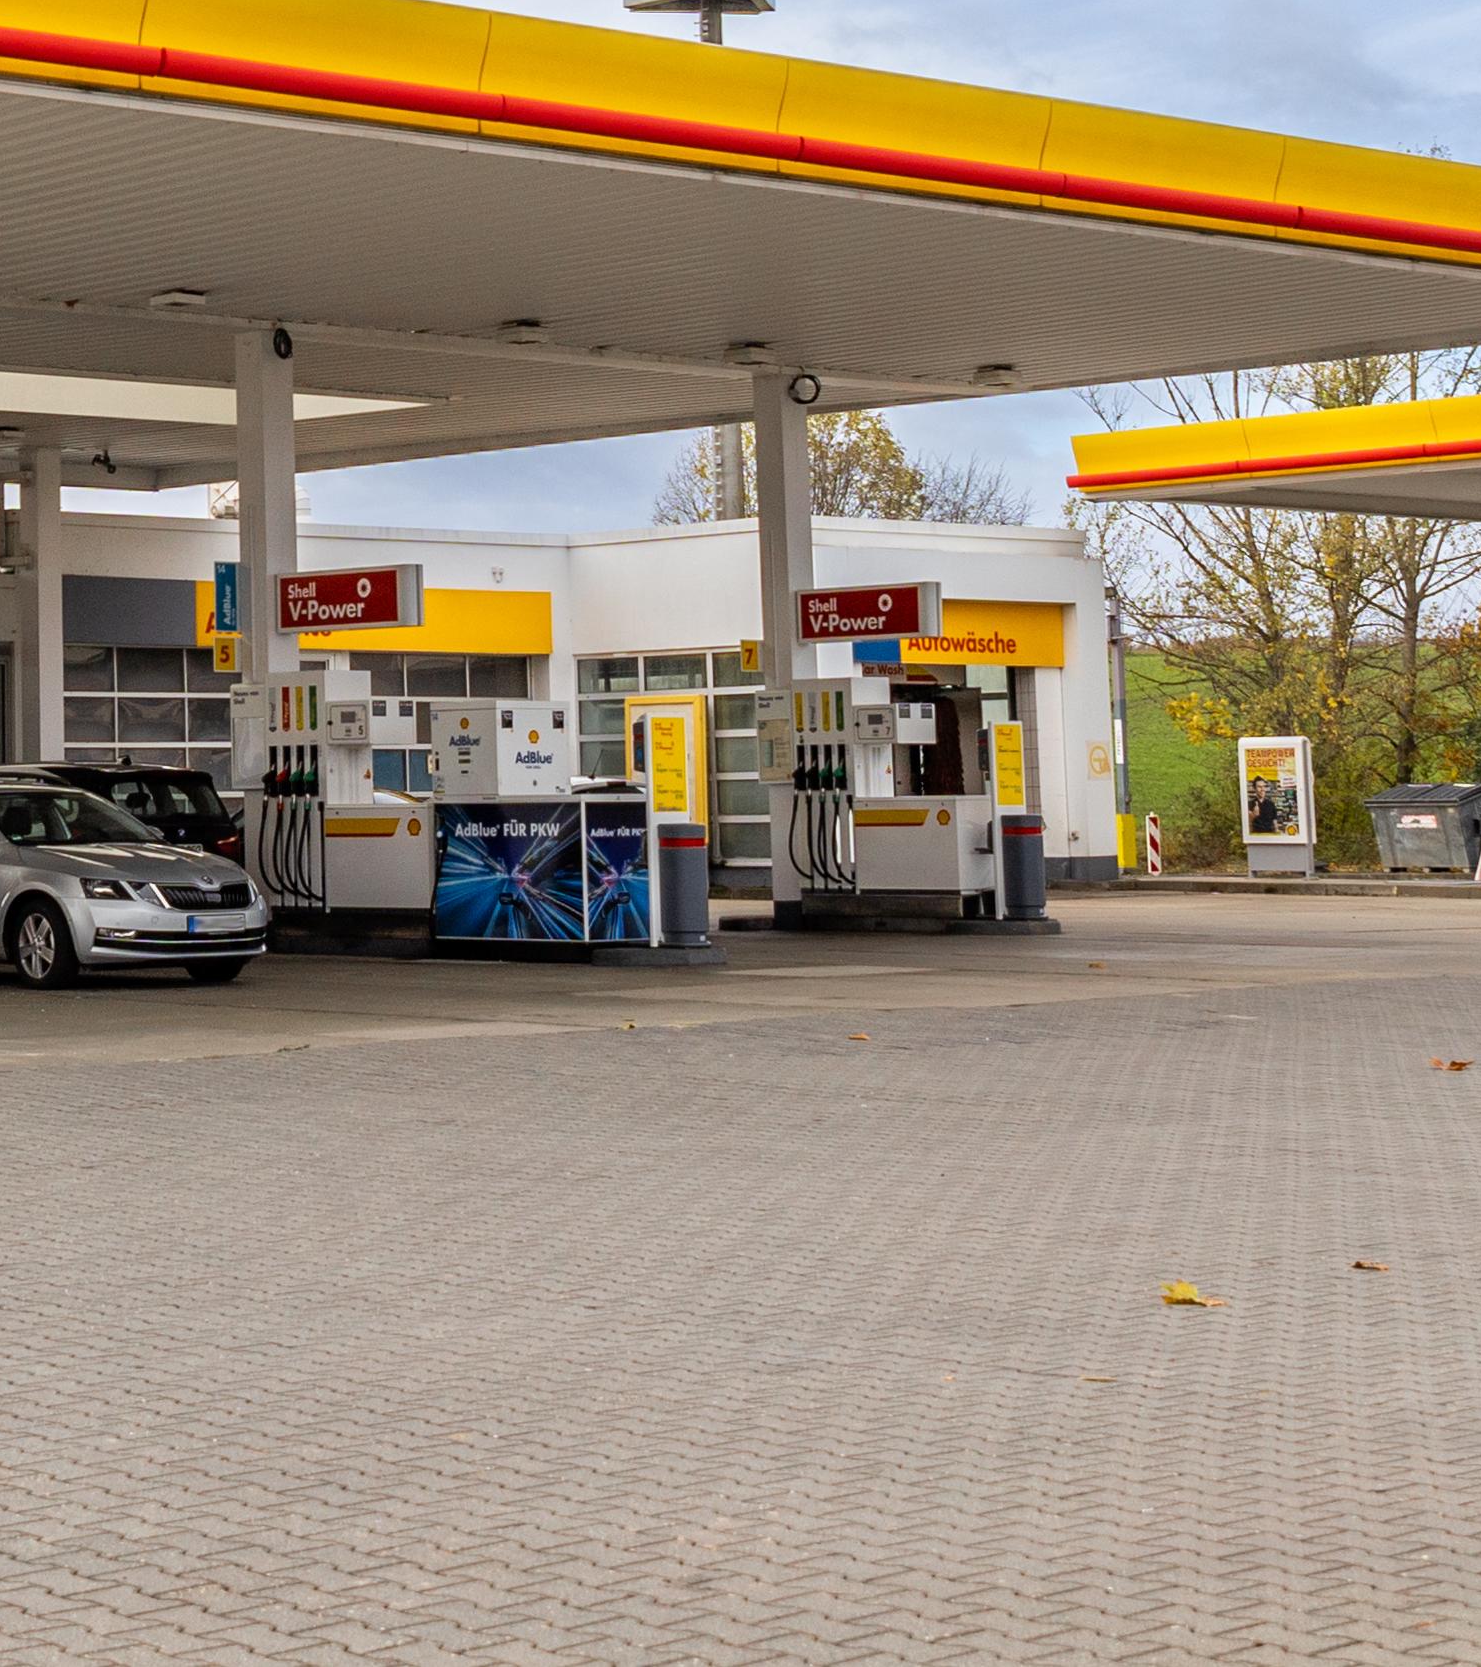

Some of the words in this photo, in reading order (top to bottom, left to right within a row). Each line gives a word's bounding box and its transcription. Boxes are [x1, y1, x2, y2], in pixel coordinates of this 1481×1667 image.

[287, 582, 316, 599] Shell
[223, 584, 231, 625] AdBlue
[288, 600, 365, 622] V-Power
[808, 598, 837, 614] Shell
[809, 615, 887, 634] V-Power
[907, 632, 1017, 654] Autowäsche
[219, 645, 230, 663] 5
[744, 649, 753, 665] 7
[862, 664, 875, 675] ar
[877, 664, 905, 675] Wash
[358, 725, 364, 735] 5
[448, 735, 479, 747] AdBlue
[515, 750, 553, 764] AdBlue
[454, 821, 498, 837] AdBlue
[503, 819, 526, 837] FÜR
[529, 822, 561, 837] PKW
[617, 825, 630, 837] FÜR
